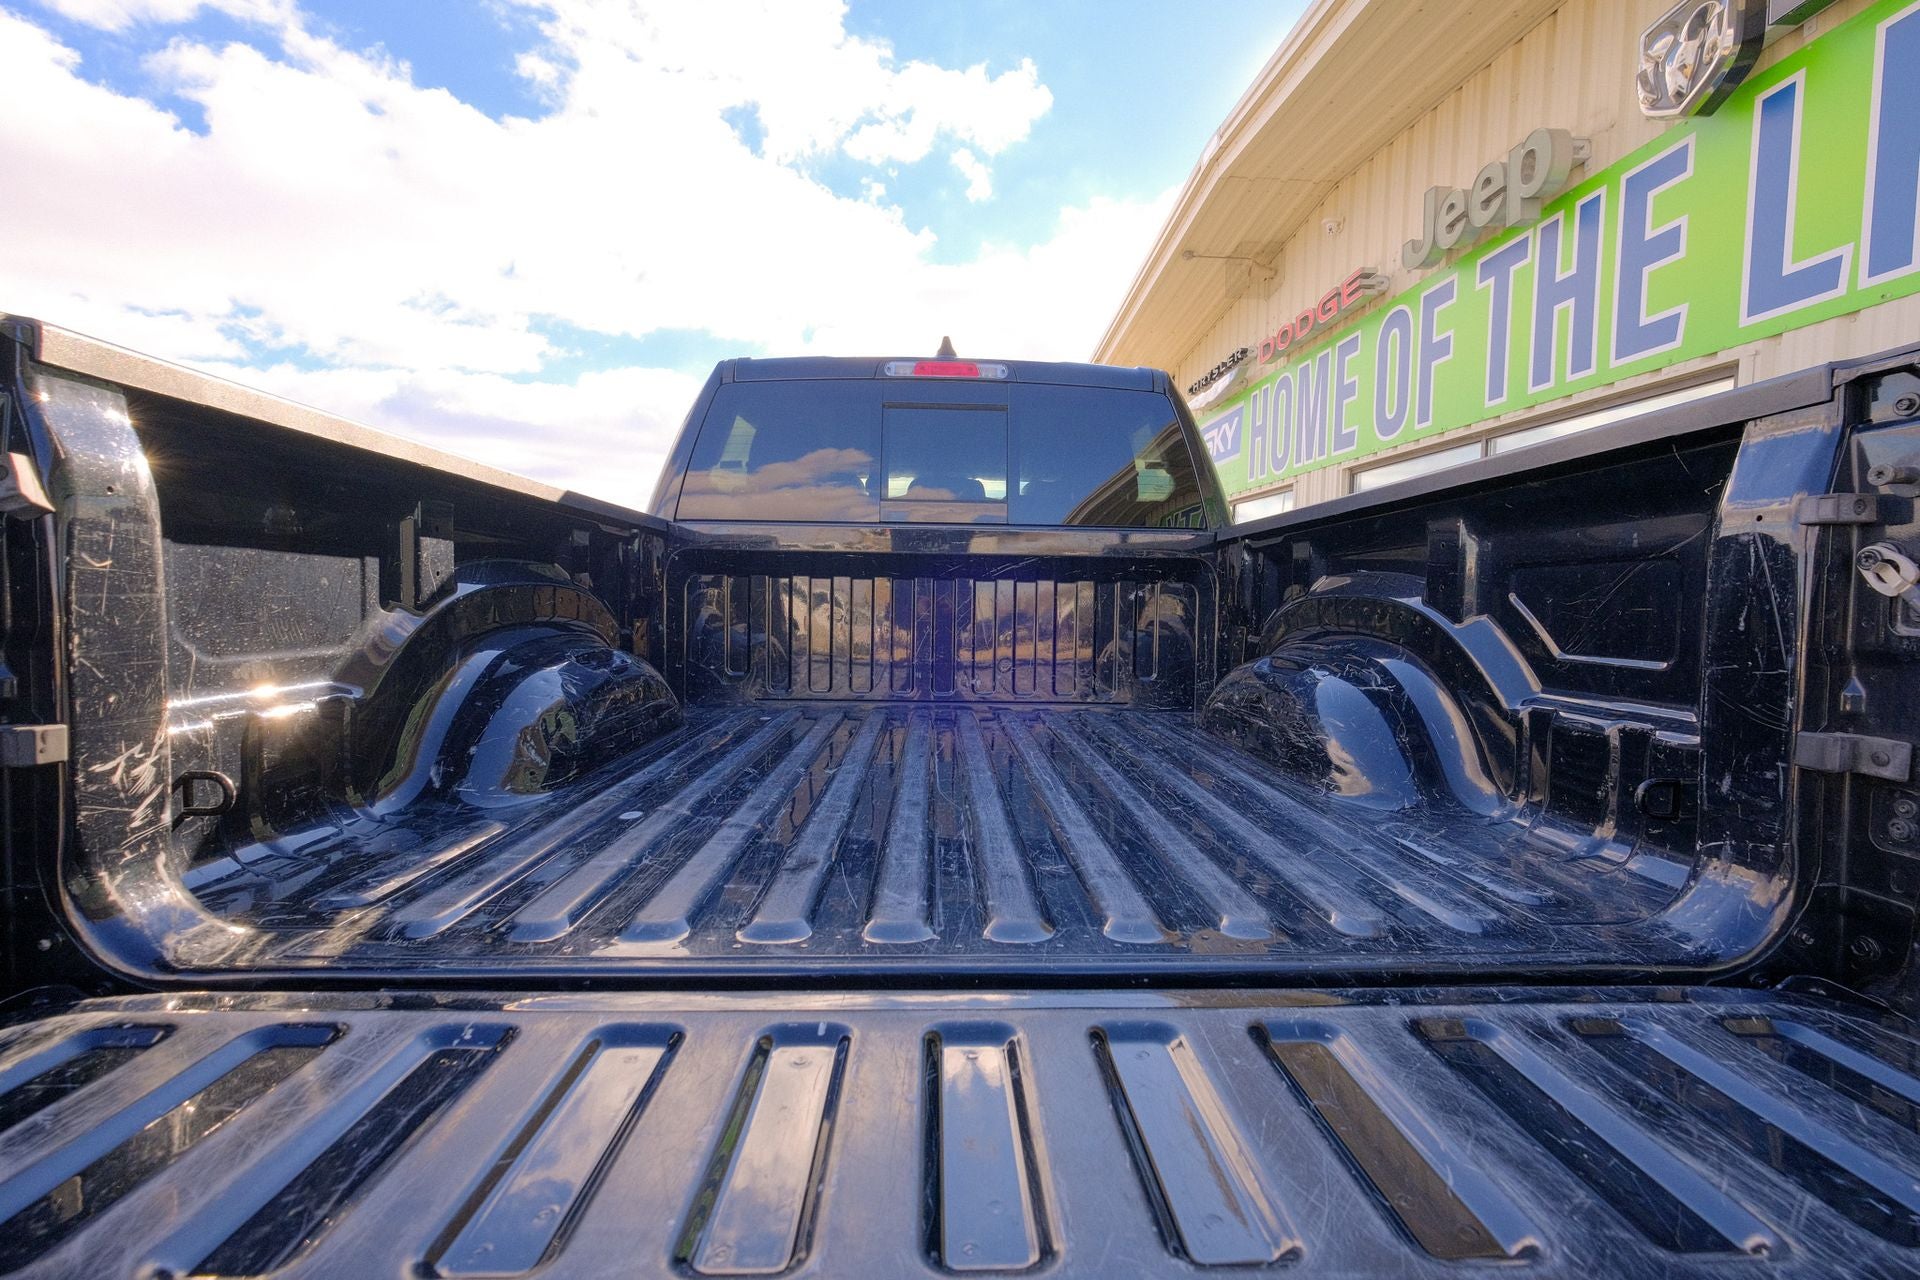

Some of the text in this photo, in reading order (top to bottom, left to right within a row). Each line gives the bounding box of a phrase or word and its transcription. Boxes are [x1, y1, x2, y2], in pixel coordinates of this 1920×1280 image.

[1402, 128, 1564, 270] Jeep
[1248, 330, 1361, 482] HOME
[1373, 273, 1458, 441] OF
[1476, 132, 1696, 408] THE
[1258, 267, 1374, 364] DODGE
[1188, 347, 1247, 395] CHRYSLER
